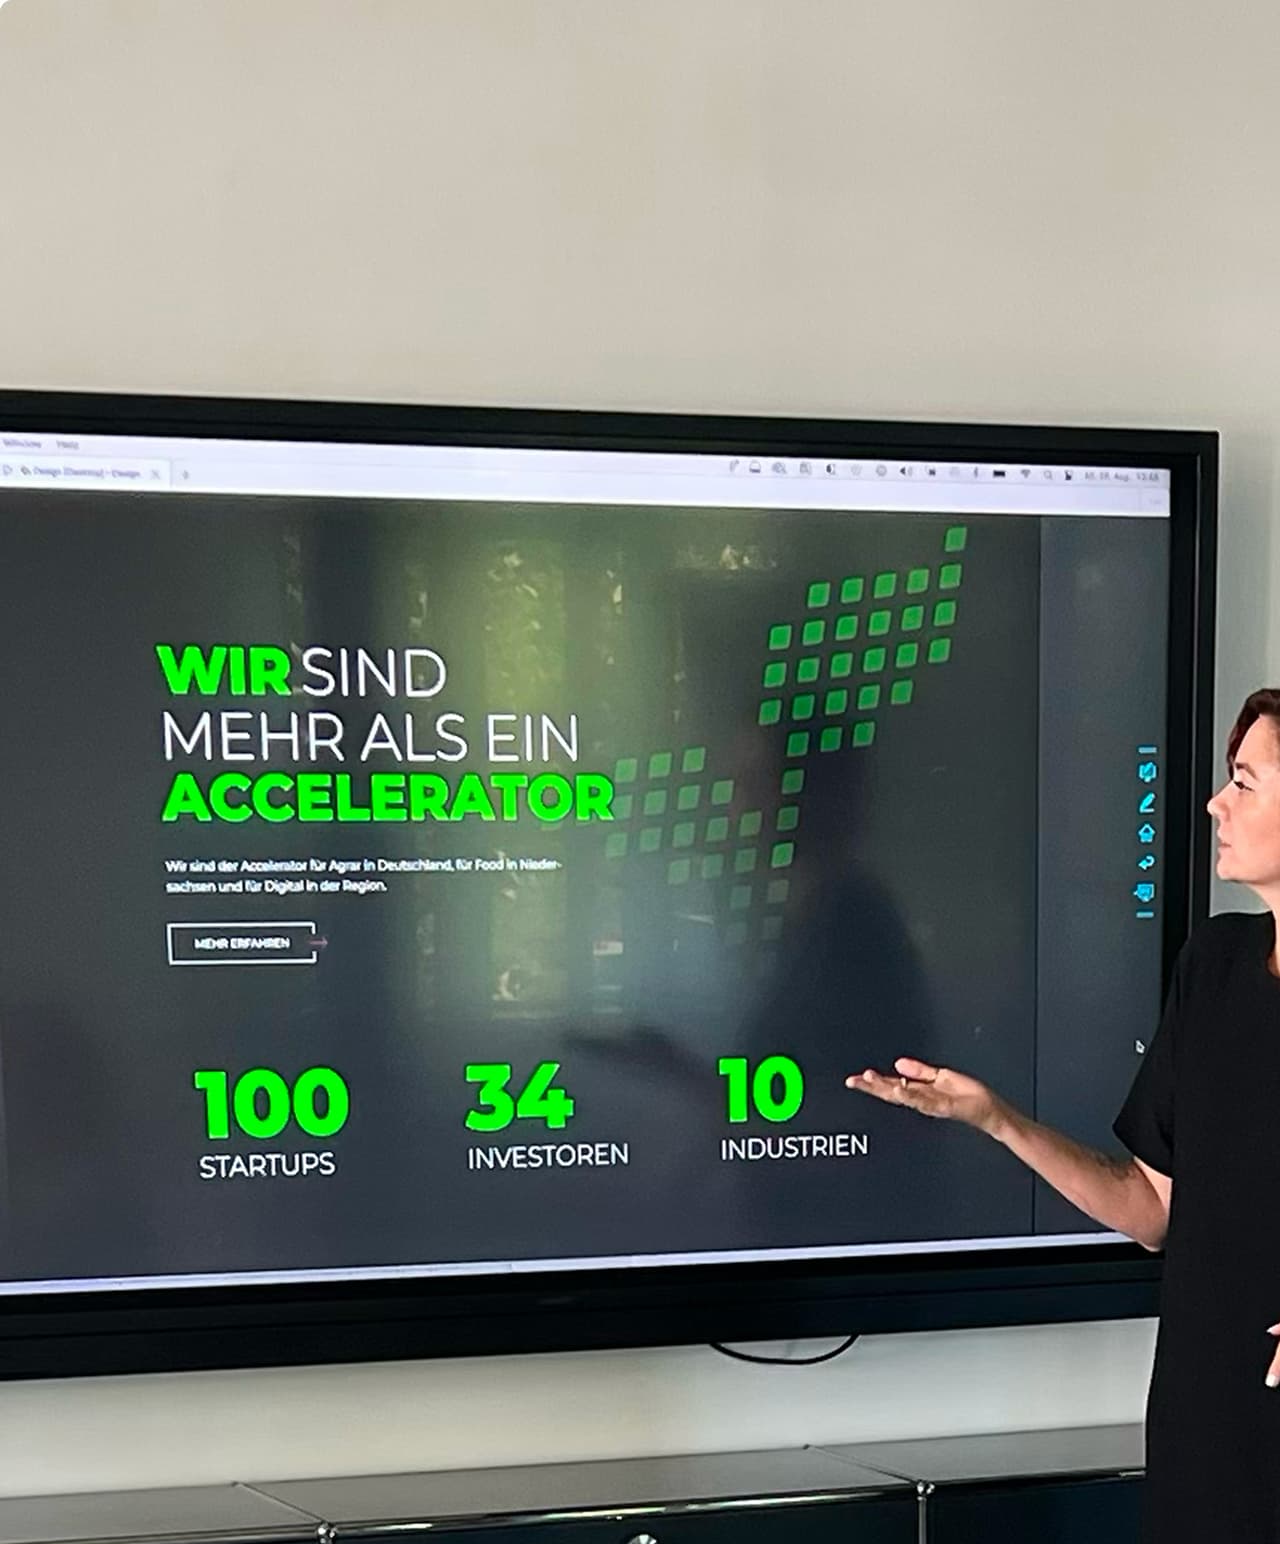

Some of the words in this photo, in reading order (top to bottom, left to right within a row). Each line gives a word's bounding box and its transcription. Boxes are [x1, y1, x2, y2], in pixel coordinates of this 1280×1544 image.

[155, 645, 292, 696] WIR
[302, 647, 447, 697] SIND
[163, 711, 345, 762] MEHR
[360, 712, 468, 763] ALS
[487, 713, 579, 763] EIN
[161, 772, 616, 823] ACCELERATOR
[164, 859, 188, 873] Wir
[189, 859, 216, 873] sind
[217, 859, 239, 873] der
[240, 858, 307, 873] Accelerator
[309, 858, 327, 873] für
[328, 858, 361, 875] Agrar
[363, 858, 376, 872] in
[377, 857, 455, 873] Deutschland,
[456, 857, 474, 871] für
[475, 857, 504, 872] Food
[506, 857, 518, 871] in
[519, 857, 563, 871] Nieder-
[165, 880, 217, 893] sachsen
[218, 880, 243, 893] und
[245, 880, 262, 893] für
[264, 879, 304, 895] Digital
[306, 879, 318, 893] in
[319, 879, 341, 892] der
[342, 879, 388, 895] Region.
[194, 937, 229, 949] MEHR
[230, 937, 290, 949] ERFAHREN
[194, 1066, 350, 1139] 100
[465, 1061, 575, 1131] 34
[718, 1055, 804, 1123] 10
[199, 1151, 336, 1179] STARTUPS
[467, 1142, 630, 1170] INVESTOREN
[721, 1134, 868, 1161] INDUSTRIEN
